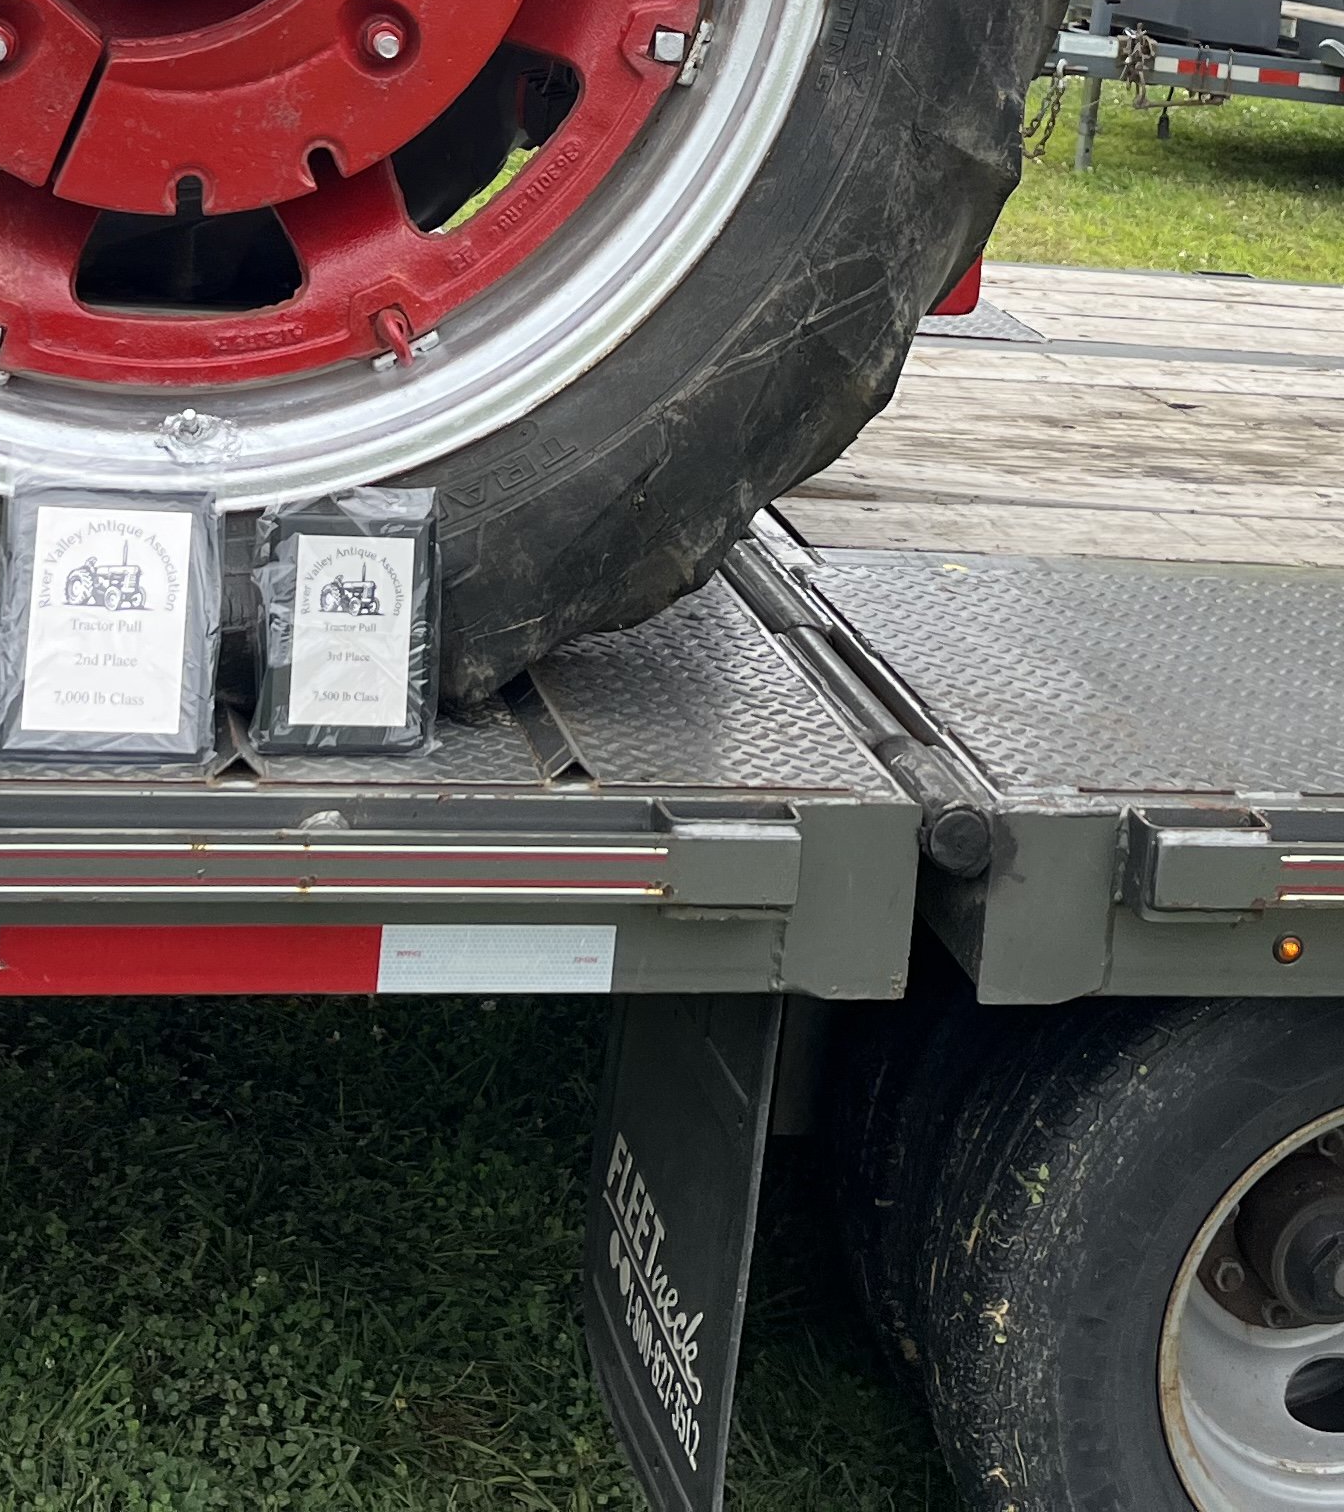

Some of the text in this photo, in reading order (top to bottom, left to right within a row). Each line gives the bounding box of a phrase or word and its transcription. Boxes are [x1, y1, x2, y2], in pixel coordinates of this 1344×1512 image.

[86, 519, 144, 539] Antique
[45, 529, 84, 567] Valley
[335, 546, 377, 561] Antique
[144, 533, 182, 612] Association
[306, 552, 334, 582] Valley
[38, 569, 54, 610] River
[300, 582, 313, 615] River
[70, 619, 143, 633] Tractor Pull
[324, 622, 377, 633] Tractor Pull
[74, 654, 138, 668] 2nd Place
[327, 651, 371, 663] 3rd Place
[54, 691, 145, 706] 7,000 lb Class
[354, 691, 379, 703] Class
